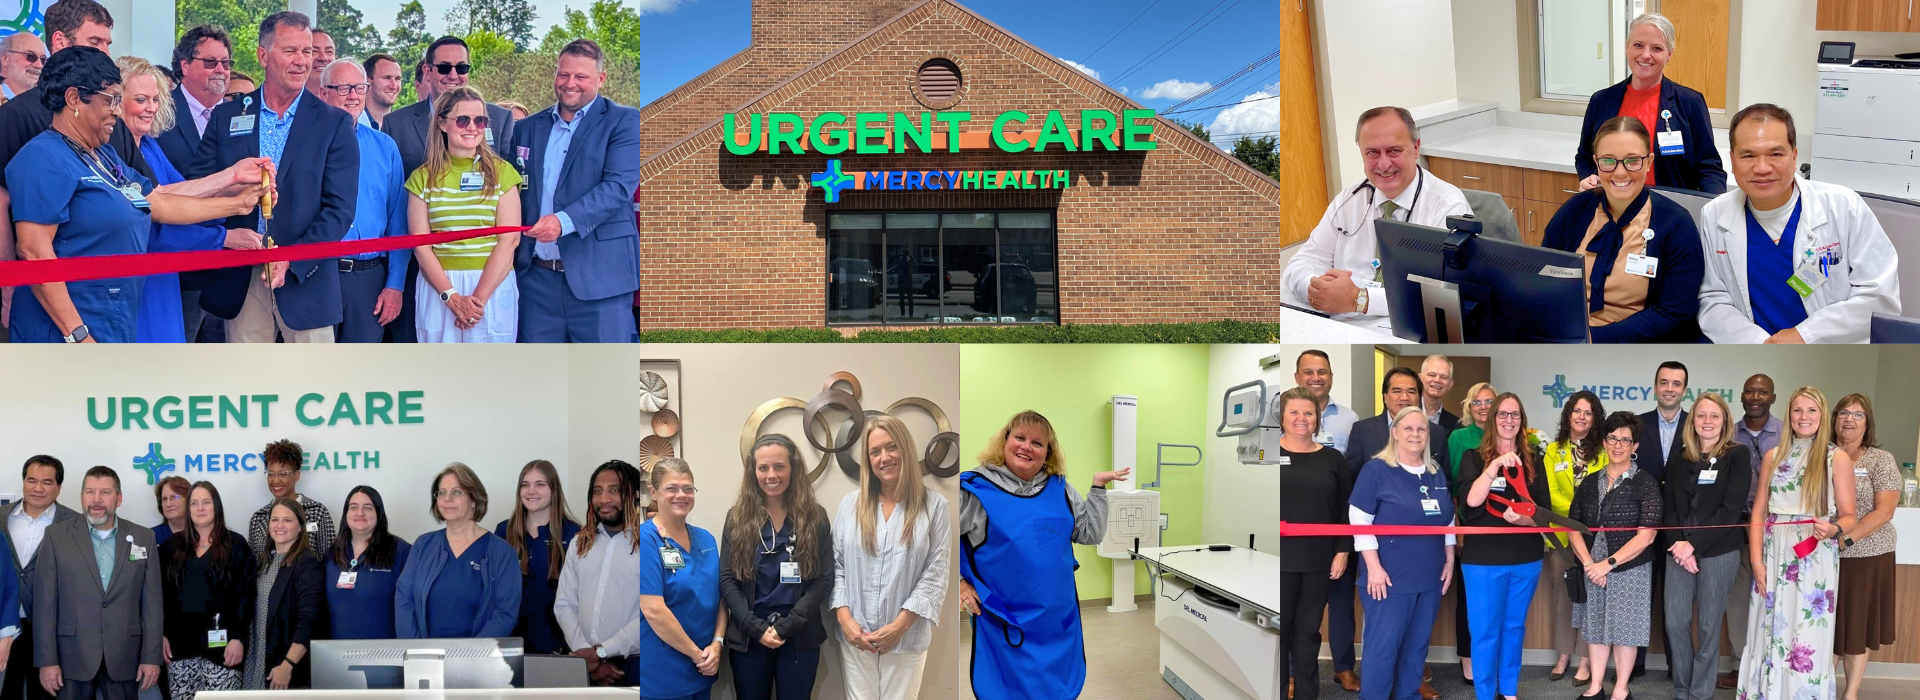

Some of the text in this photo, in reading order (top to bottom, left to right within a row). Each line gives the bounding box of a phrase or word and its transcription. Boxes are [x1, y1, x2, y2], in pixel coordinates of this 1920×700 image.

[724, 109, 1157, 155] URGENT CARE
[865, 170, 1070, 190] MERCYHEALTH
[1549, 268, 1574, 277] ViewSonic
[1789, 279, 1808, 295] Physician
[87, 390, 424, 430] URGENT CARE
[184, 450, 380, 473] MERCEALTH
[1183, 604, 1208, 622] DEL MEDICAL
